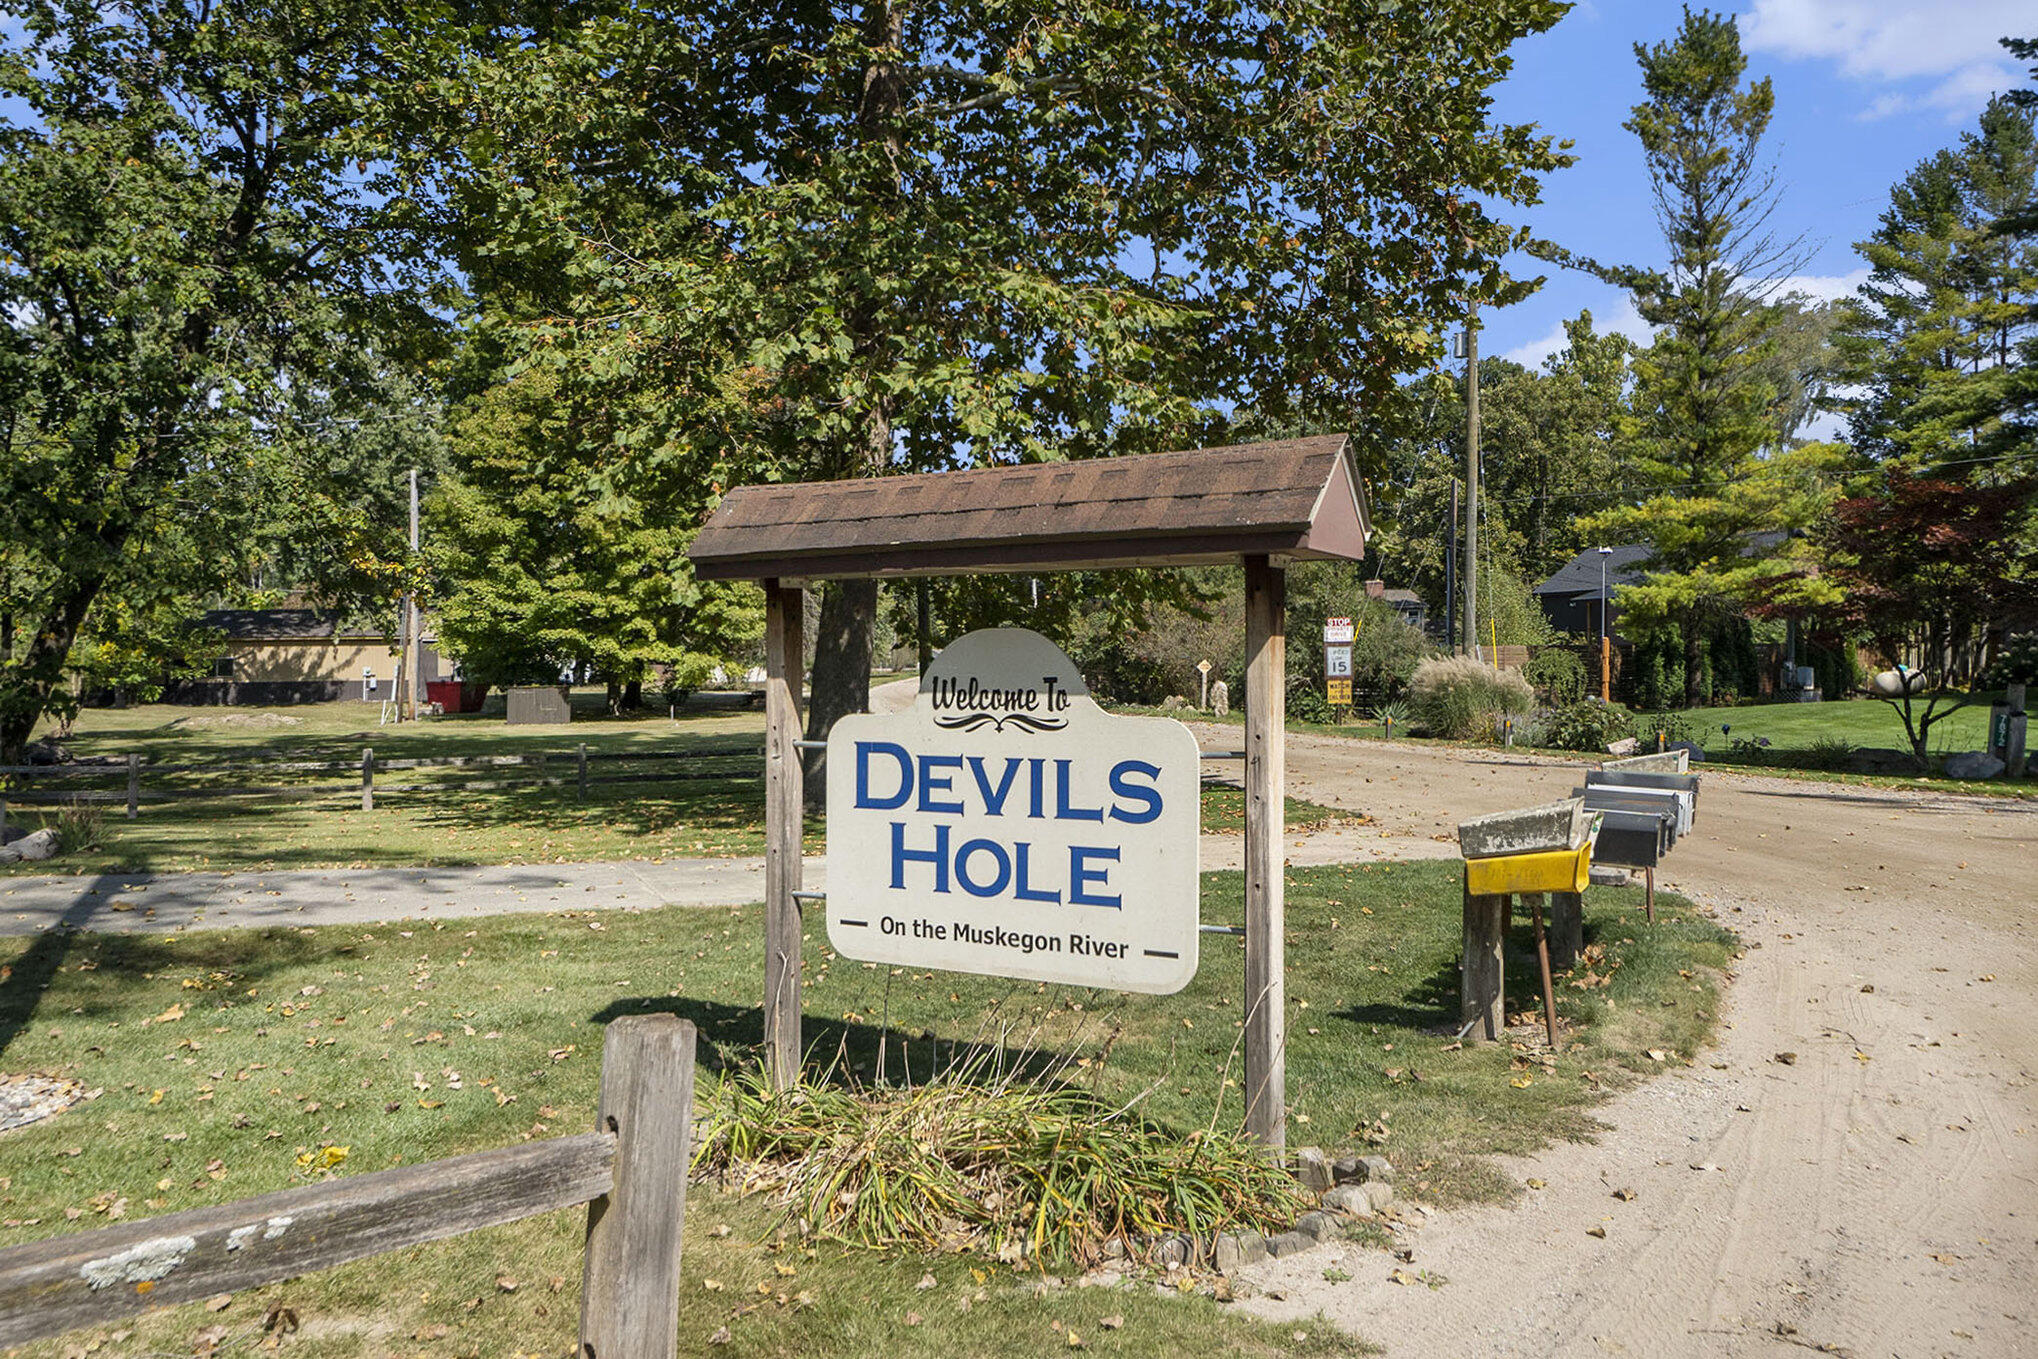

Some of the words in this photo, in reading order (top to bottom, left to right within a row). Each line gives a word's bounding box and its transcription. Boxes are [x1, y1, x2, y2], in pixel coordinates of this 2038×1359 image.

[1327, 618, 1351, 627] STOP
[1333, 661, 1347, 673] 15
[932, 676, 1039, 711] Welcome
[1043, 676, 1071, 712] To
[854, 741, 1163, 825] DEVILS
[889, 822, 1122, 911] HOLE
[880, 916, 906, 936] On
[912, 918, 947, 940] the
[953, 922, 1062, 954] Muskegon
[1069, 934, 1129, 959] River
